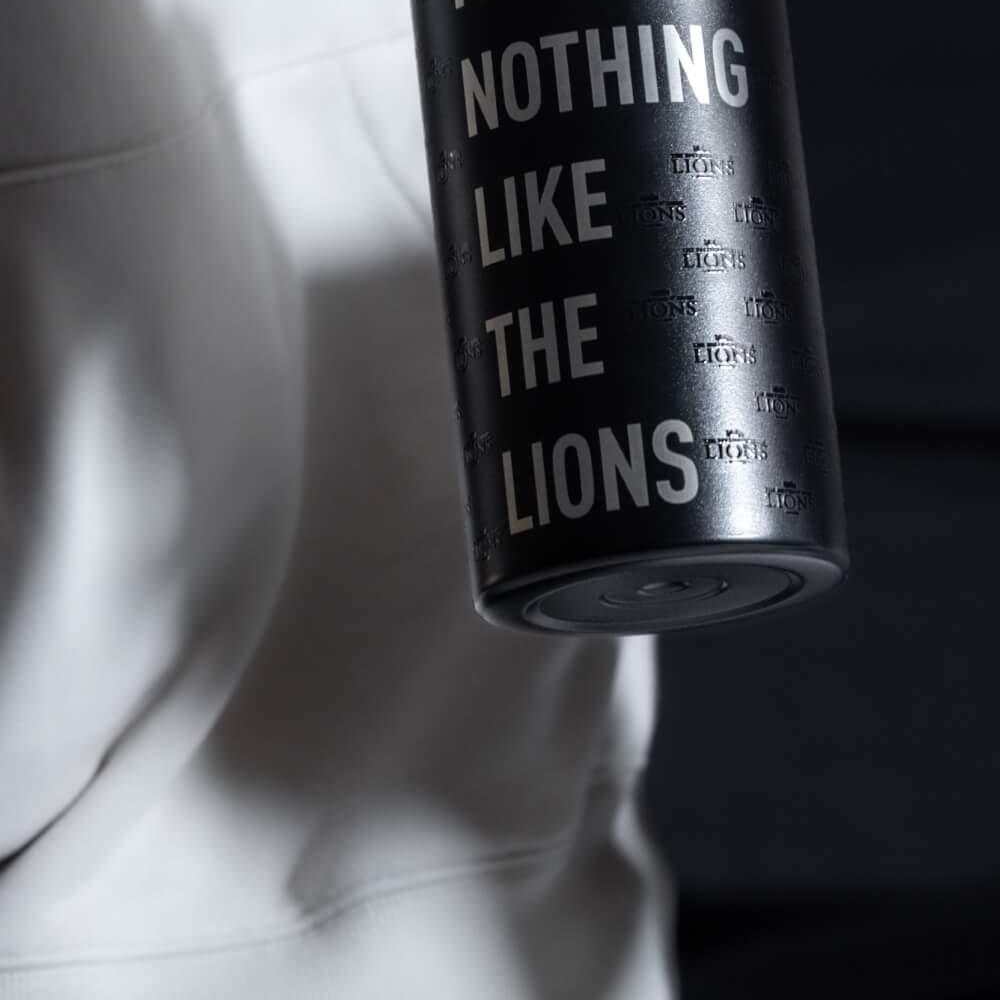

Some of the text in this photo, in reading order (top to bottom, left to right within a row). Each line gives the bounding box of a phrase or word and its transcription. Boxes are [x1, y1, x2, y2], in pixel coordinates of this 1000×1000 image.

[460, 24, 749, 138] NOTHING
[672, 158, 735, 176] LIONS
[474, 158, 613, 268] LIKE
[683, 252, 746, 270] LIONS
[485, 292, 605, 399] THE
[694, 347, 757, 365] LIONS
[501, 419, 700, 536] LIONS
[704, 442, 767, 460] LIONS
